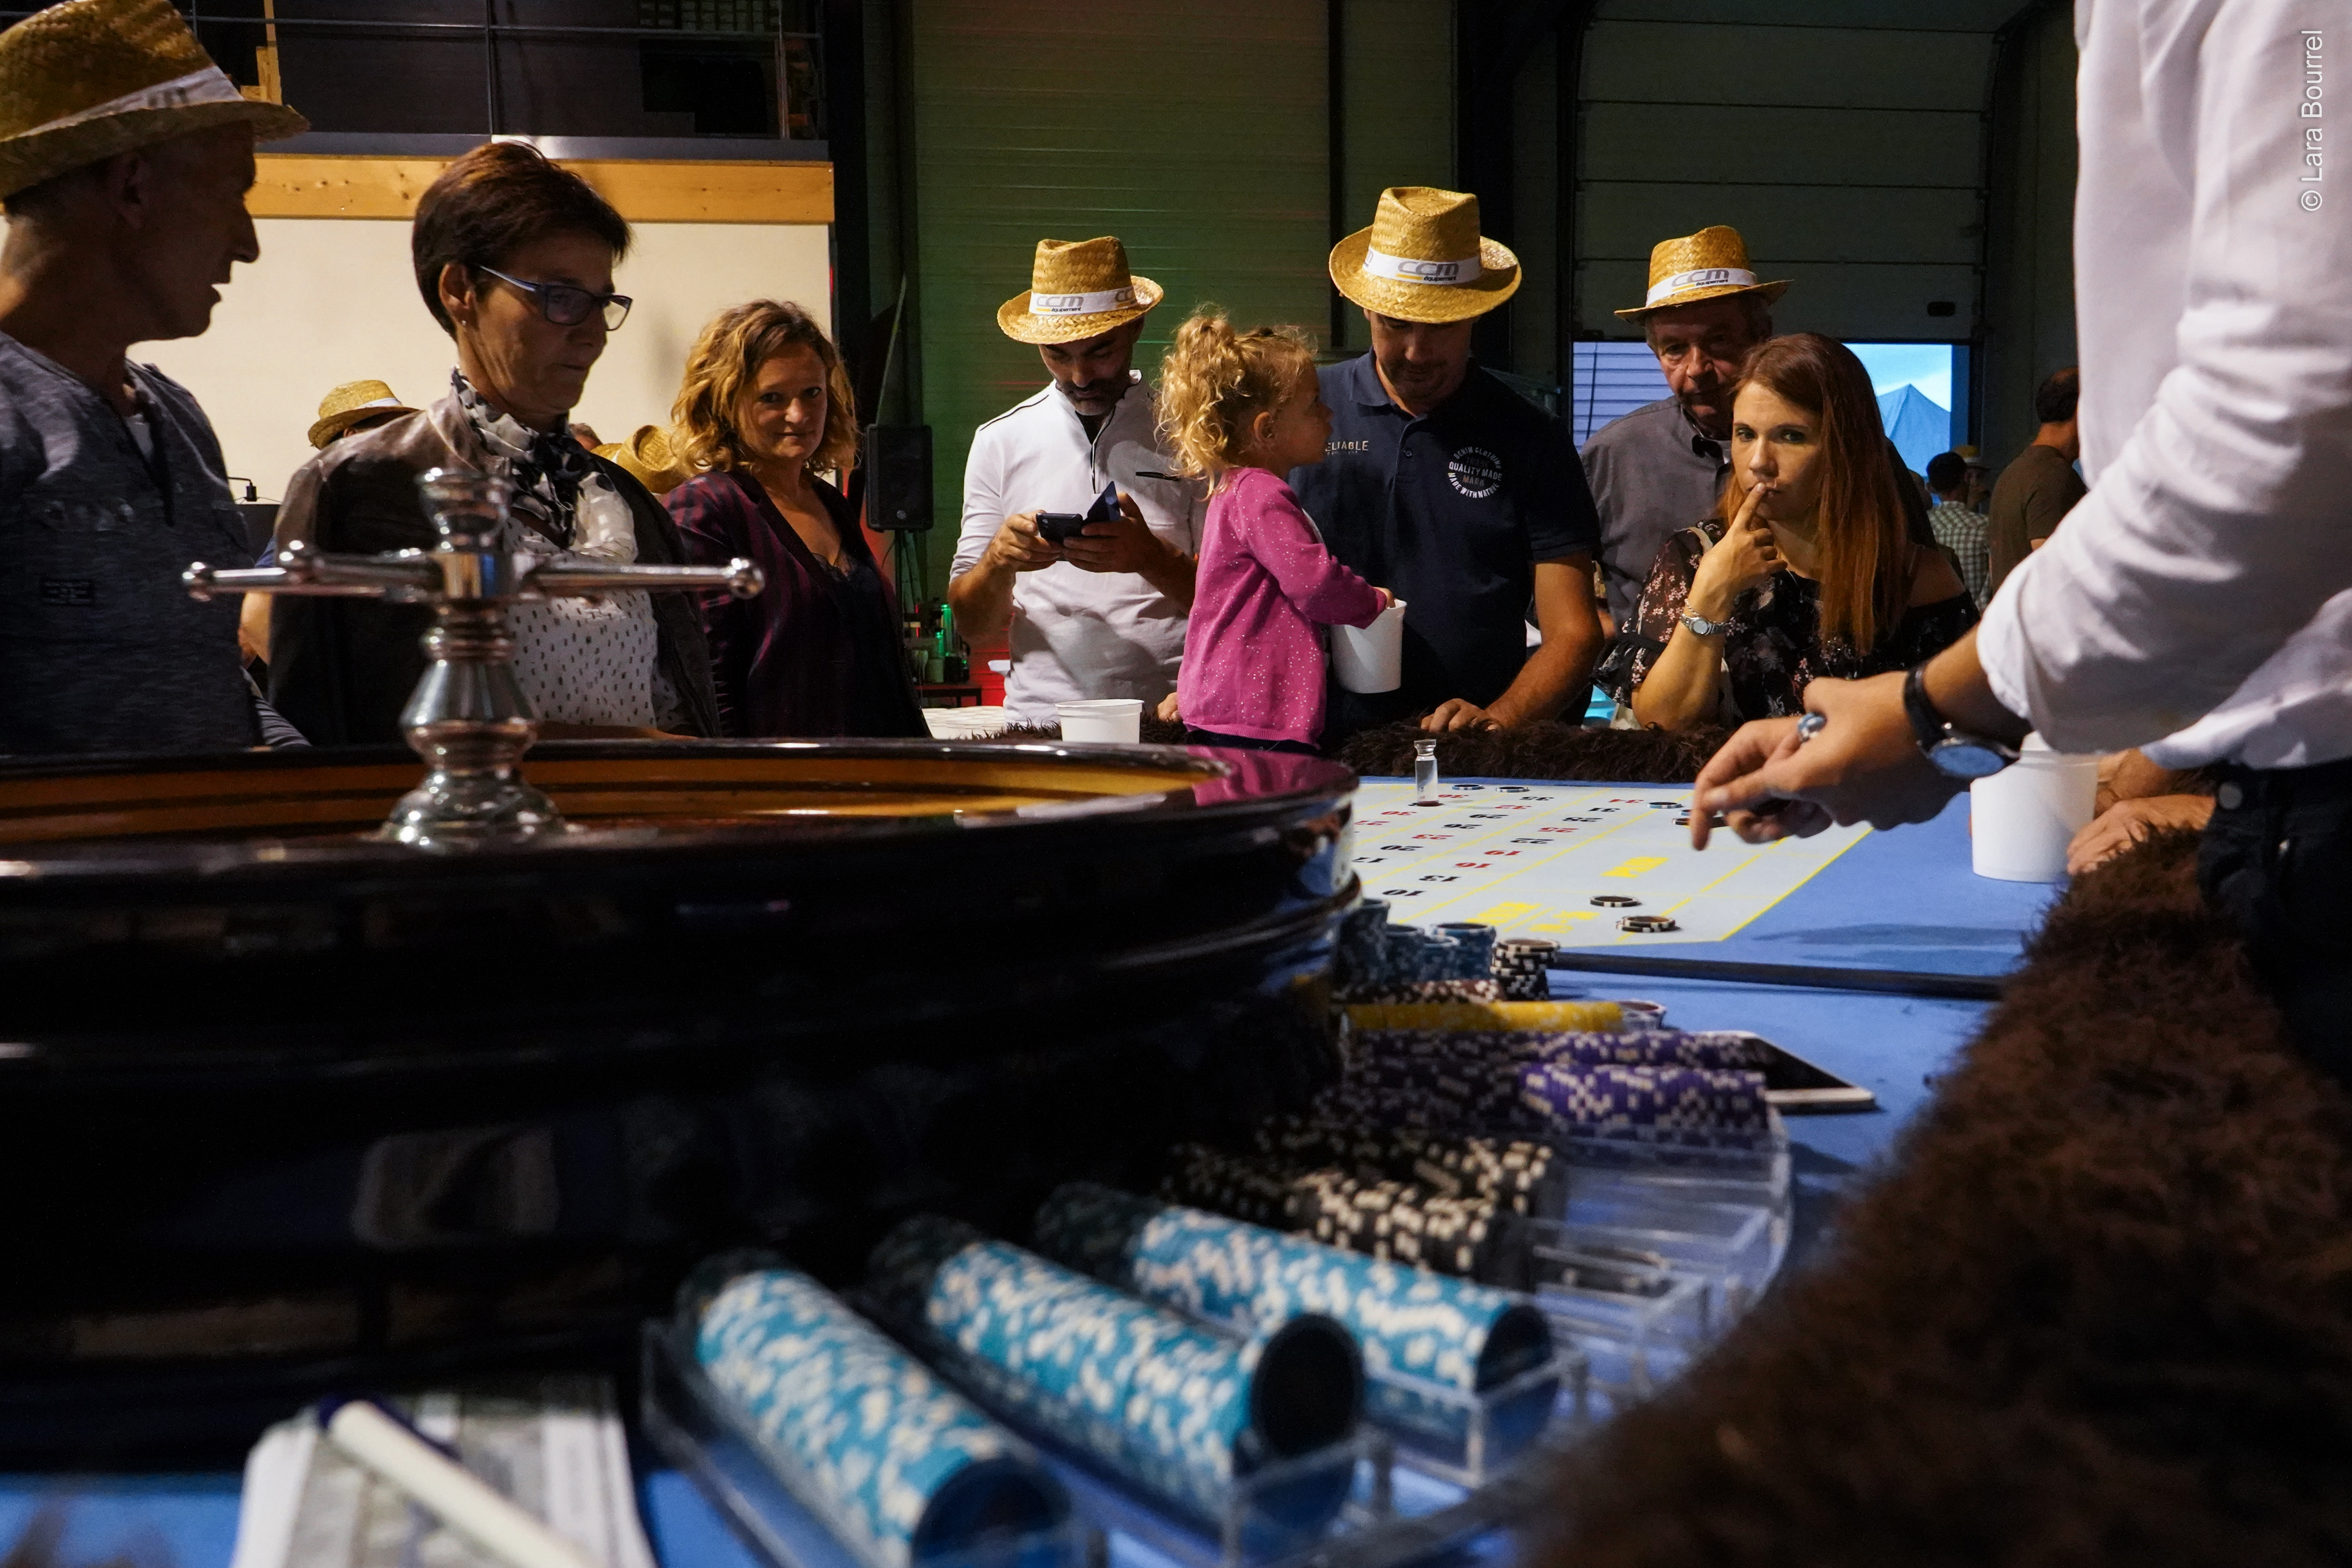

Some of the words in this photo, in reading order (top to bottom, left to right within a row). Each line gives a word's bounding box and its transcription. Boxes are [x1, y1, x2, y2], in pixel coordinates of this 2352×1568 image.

[1454, 446, 1473, 459] DENIM
[1475, 447, 1502, 469] CLOTHING
[1449, 461, 1481, 476] QUALITY
[1481, 469, 1503, 481] MADE
[1463, 474, 1485, 486] MARK
[1447, 472, 1462, 490] MADE
[1460, 487, 1477, 499] WITH
